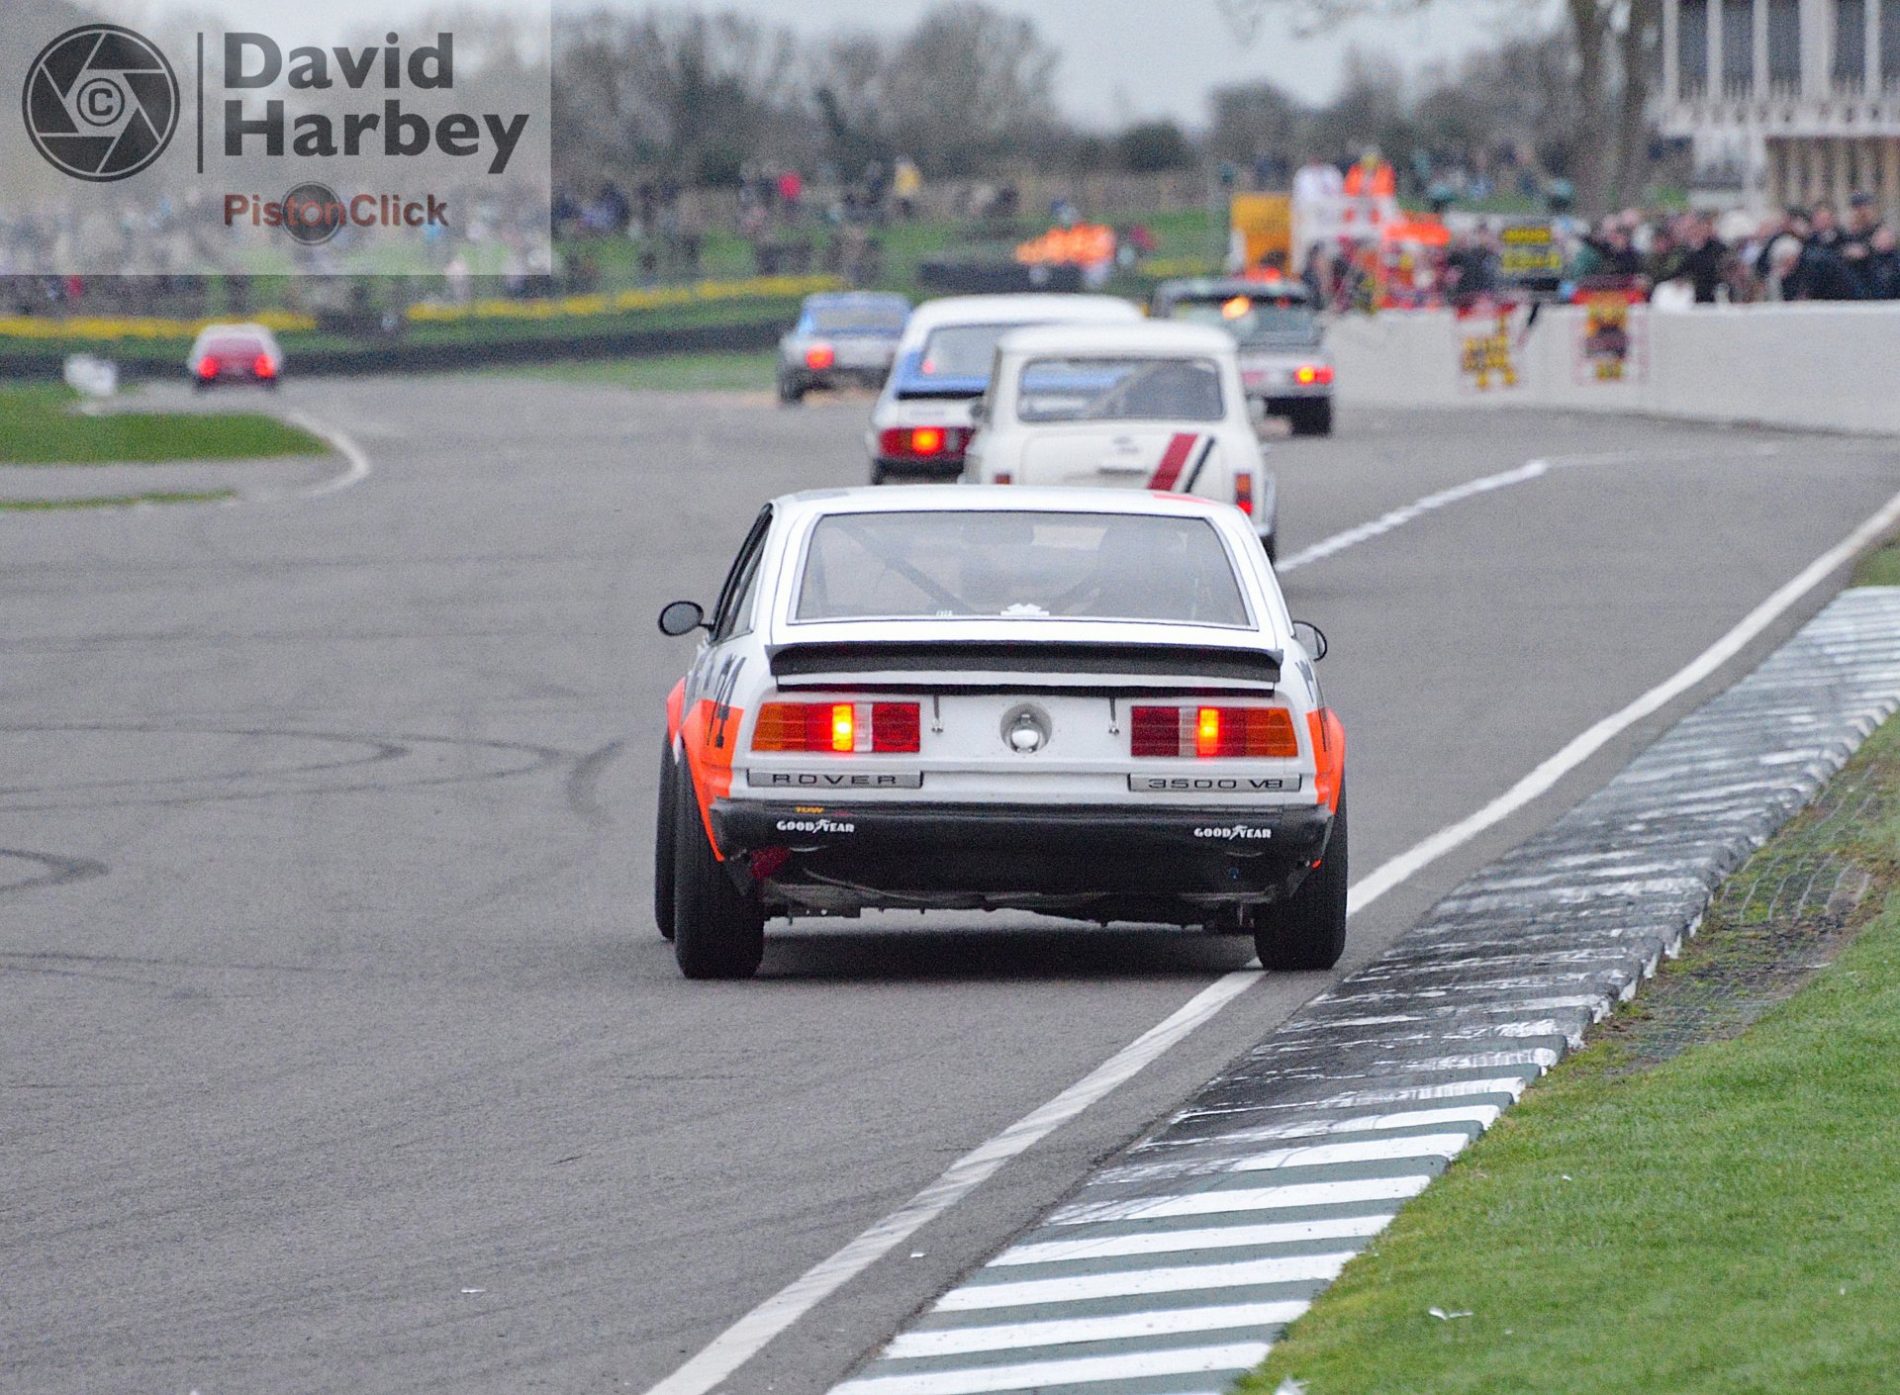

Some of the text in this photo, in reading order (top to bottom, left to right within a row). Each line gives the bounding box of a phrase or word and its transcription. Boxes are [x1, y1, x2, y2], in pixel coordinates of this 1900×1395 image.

[772, 773, 896, 785] ROVER
[1148, 778, 1283, 789] 3500 V8
[776, 819, 855, 833] GOODYEAR
[1193, 824, 1272, 840] GOODYEAR
